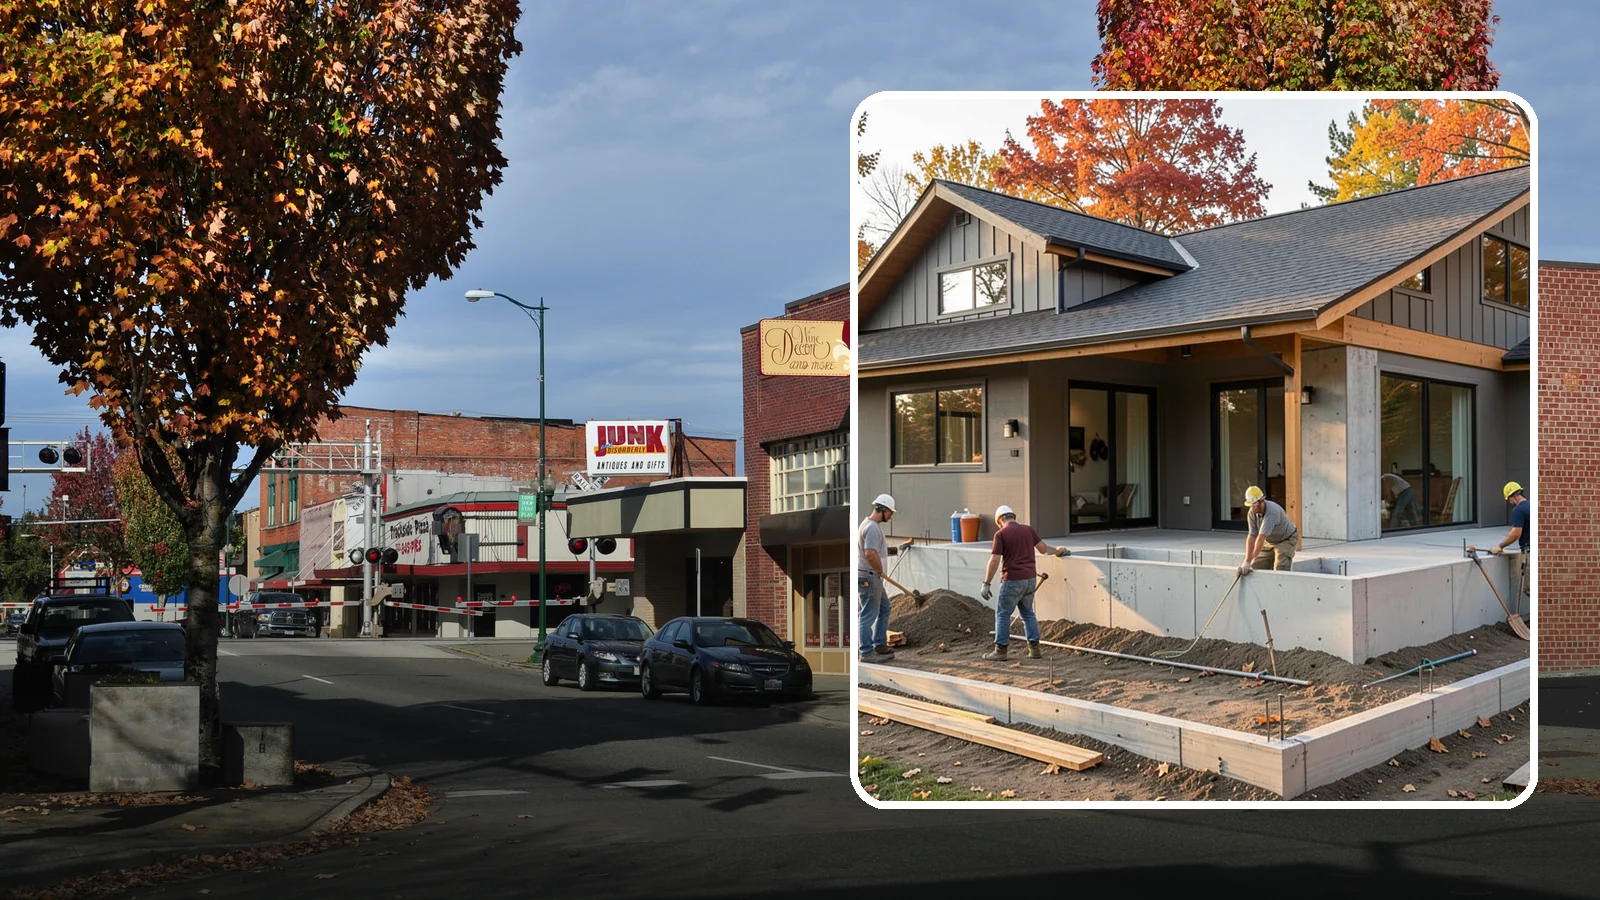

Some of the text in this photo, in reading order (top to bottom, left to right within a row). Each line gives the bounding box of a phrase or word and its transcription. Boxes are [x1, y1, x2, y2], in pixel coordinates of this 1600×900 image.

[595, 425, 665, 457] JUNK
[607, 446, 645, 454] DISORDERLY
[597, 460, 665, 470] ANTIQUES AND GIFTS
[414, 519, 429, 535] Pizza
